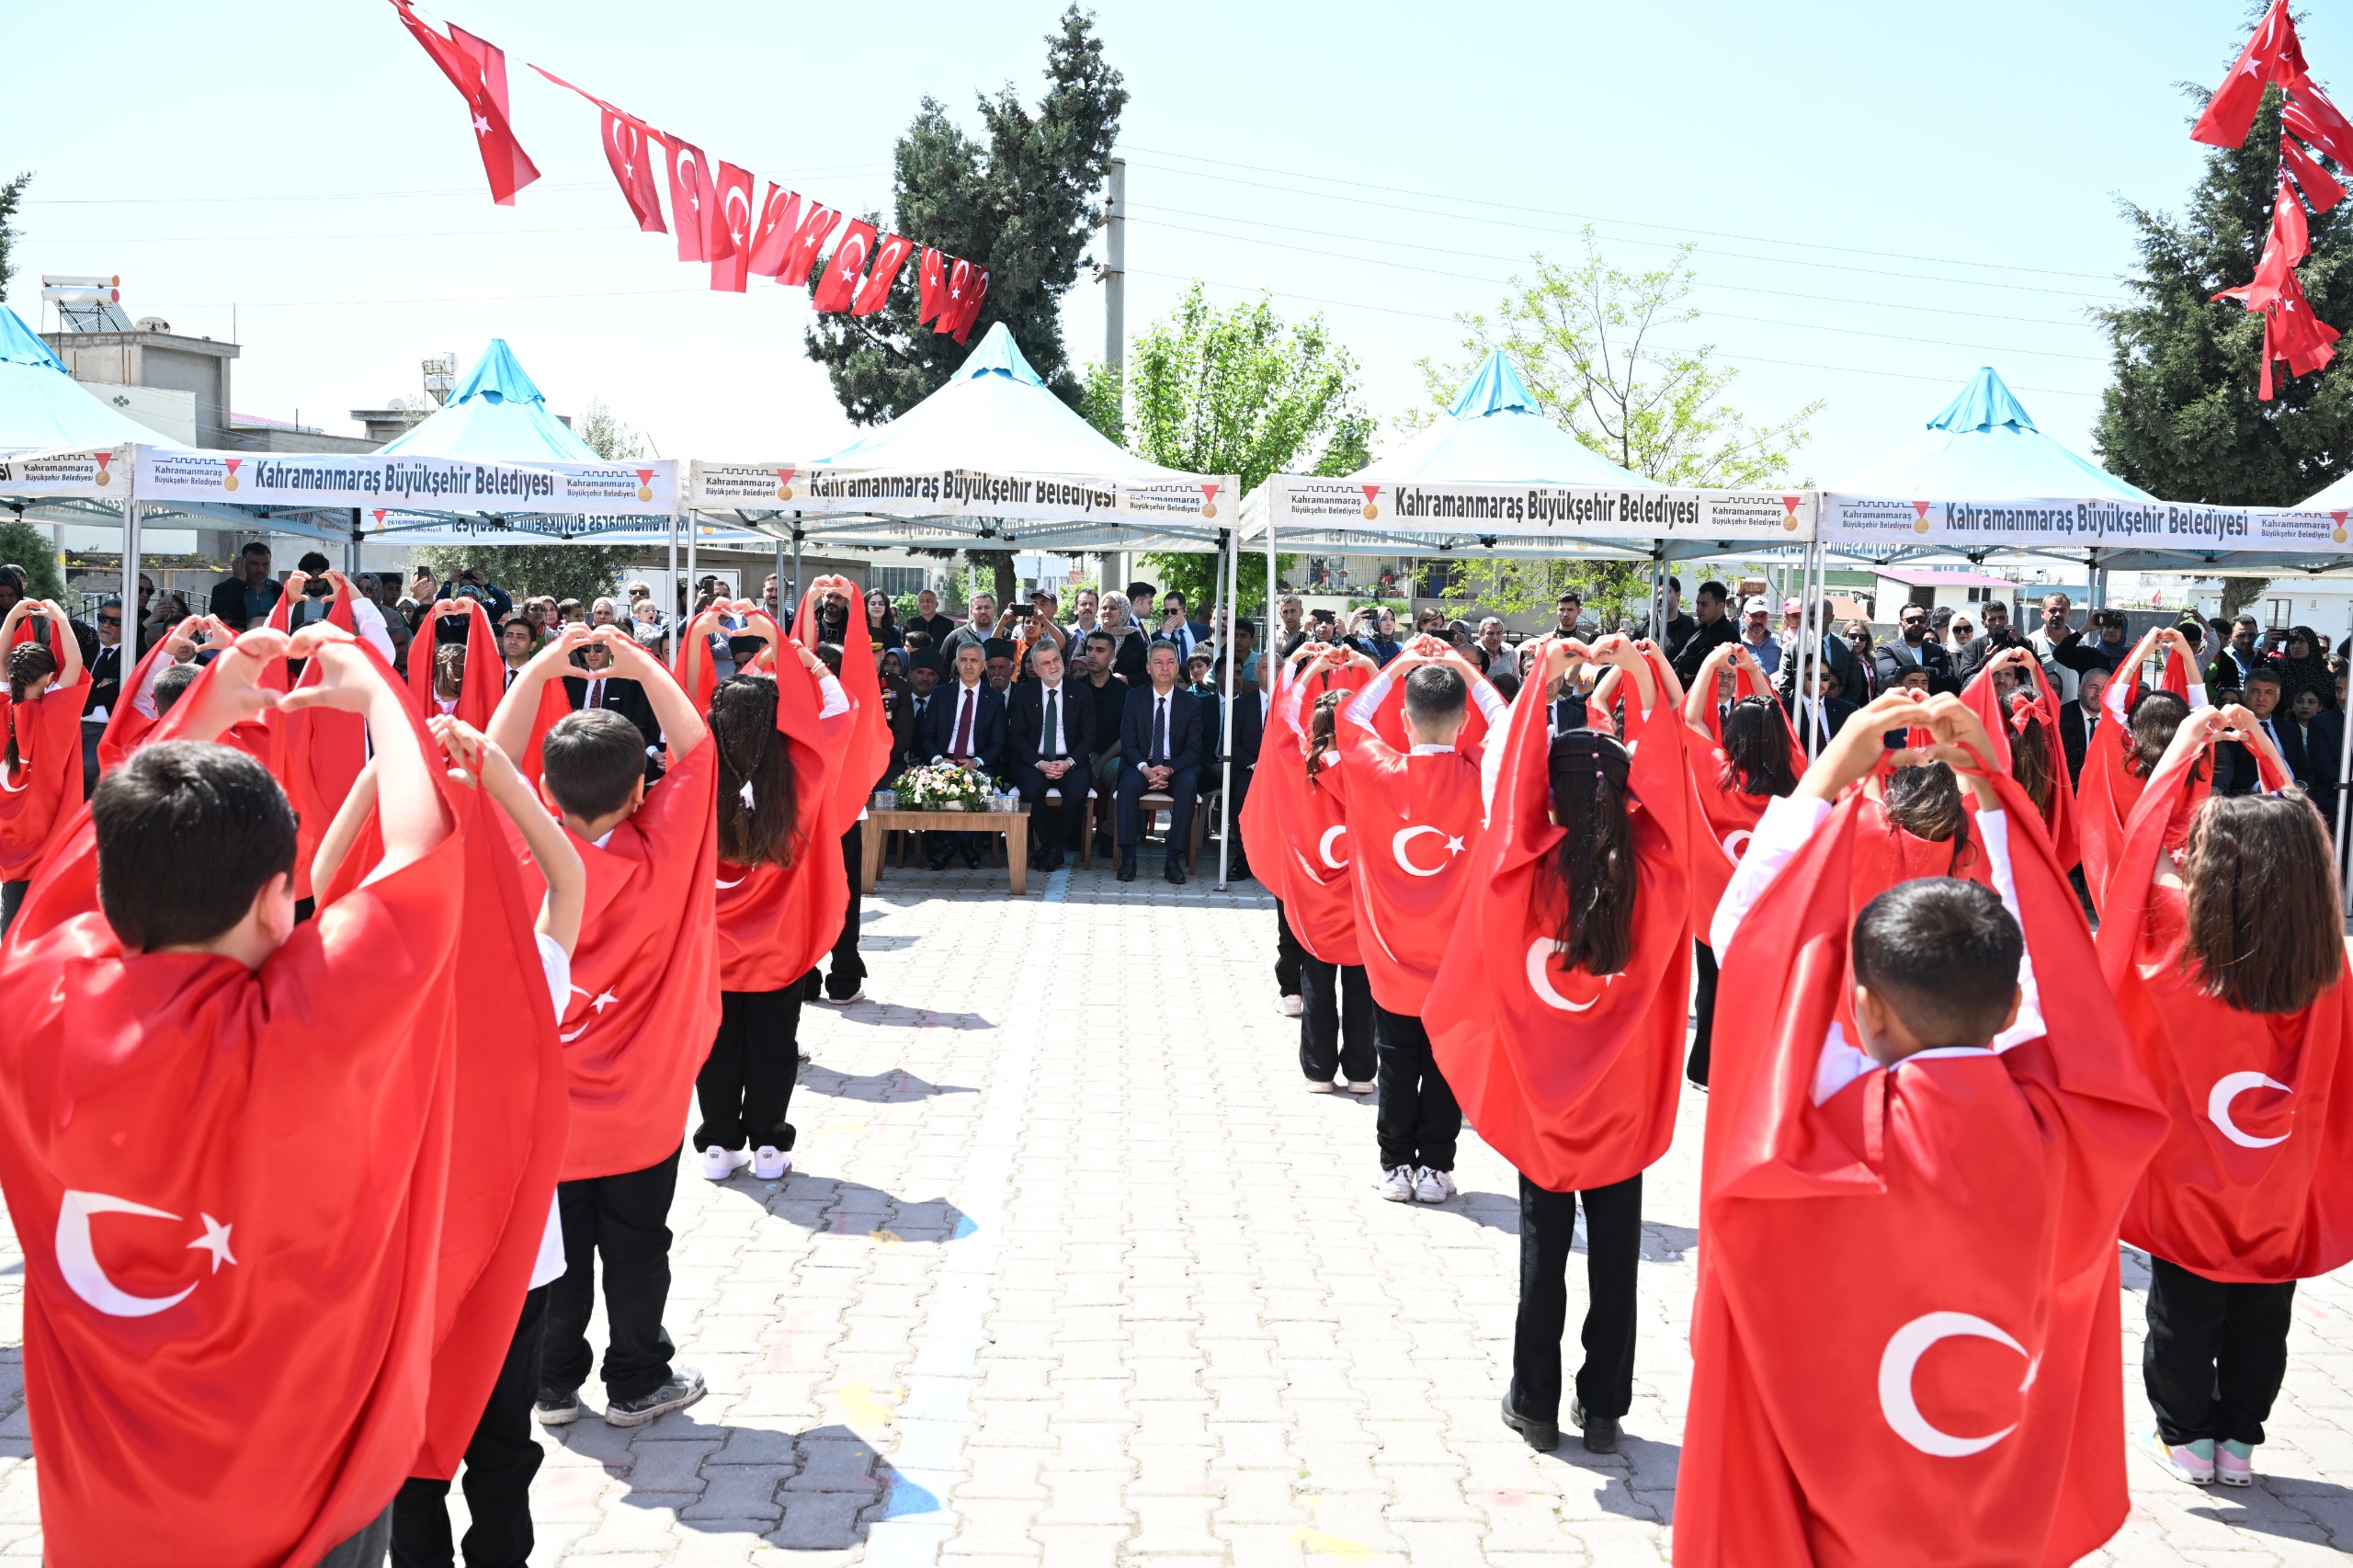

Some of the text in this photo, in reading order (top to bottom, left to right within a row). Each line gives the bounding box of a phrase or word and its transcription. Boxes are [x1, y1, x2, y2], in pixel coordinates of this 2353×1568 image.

[23, 463, 94, 473] Kahramanmaraş
[154, 465, 222, 479] Kahramanmaraş
[25, 473, 94, 483] Büyükşehir Belediyesi
[154, 475, 222, 488] Büyükşehir Belediyesi
[255, 460, 554, 503] Kahramanmaraş Büyükşehir Belediyesi
[566, 478, 636, 490] Kahramanmaraş
[706, 476, 776, 488] Kahramanmaraş
[567, 488, 636, 500] Büyükşehir Belediyesi
[706, 487, 776, 497] Büyükşehir Belediyesi
[810, 469, 1117, 513] Kahramanmaraş Büyükşehir Belediyesi
[1291, 494, 1361, 506] Kahramanmaraş
[1130, 502, 1200, 514] Büyükşehir Belediyesi
[1291, 506, 1361, 516] Büyükşehir Belediyesi
[1395, 486, 1699, 529] Kahramanmaraş Büyükşehir Belediyesi
[1712, 506, 1781, 517] Kahramanmaraş
[1843, 510, 1912, 521] Kahramanmaraş
[1711, 517, 1781, 528] Büyükşehir Belediyesi
[1843, 520, 1912, 530] Büyükşehir Belediyesi
[1946, 503, 2248, 541] Kahramanmaraş Büyükşehir Belediyesi
[2262, 519, 2331, 530] Kahramanmaraş
[2262, 529, 2331, 540] Büyükşehir Belediyesi
